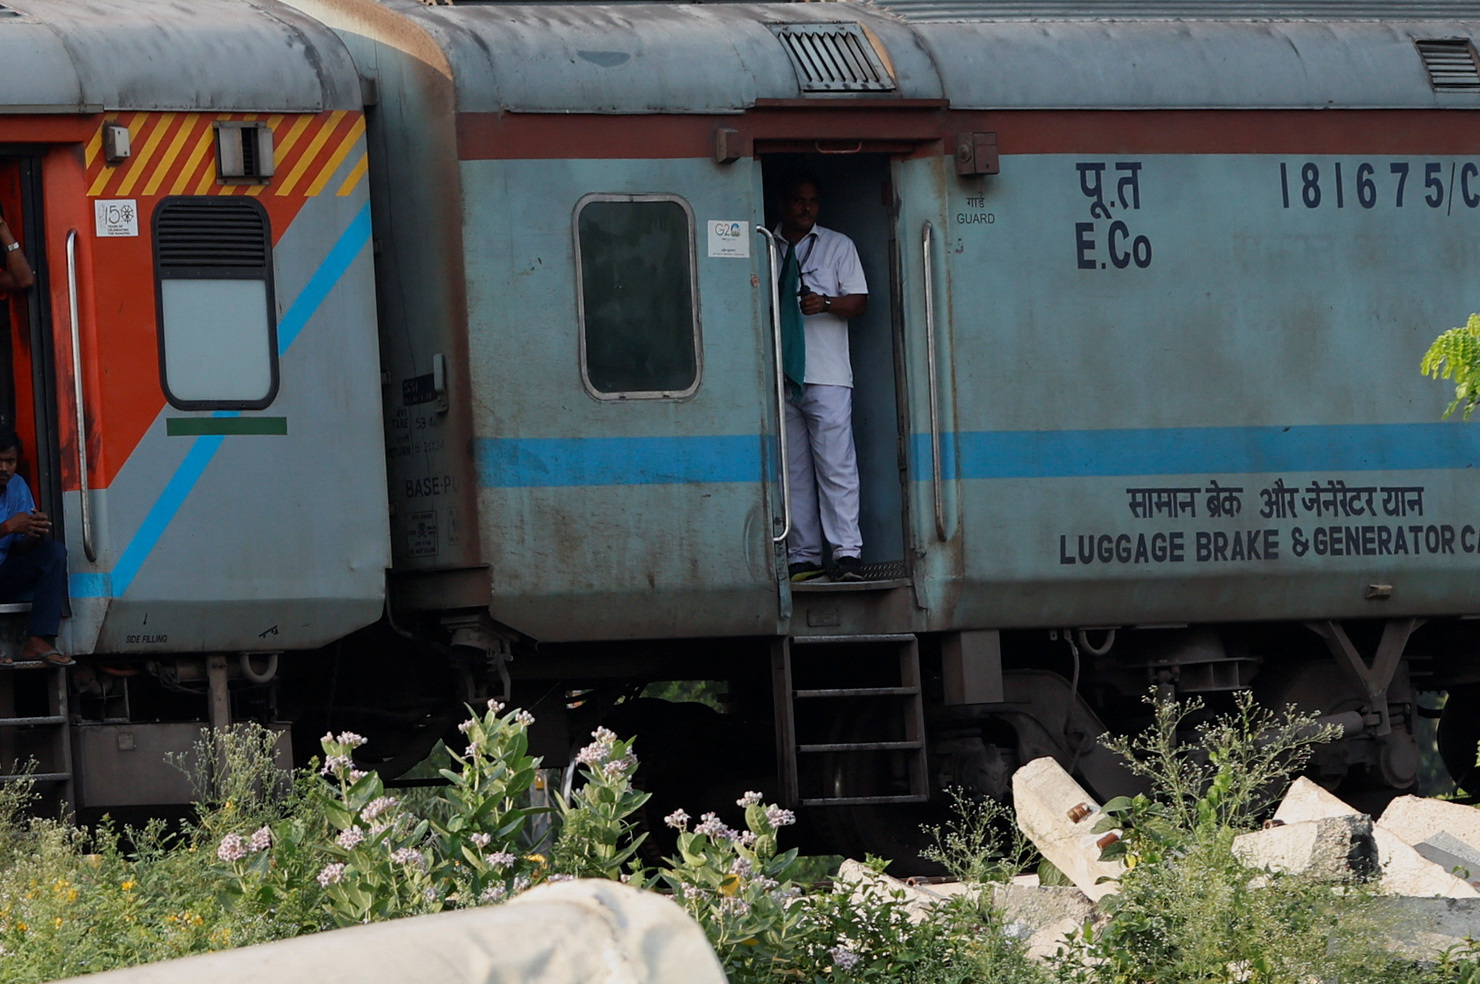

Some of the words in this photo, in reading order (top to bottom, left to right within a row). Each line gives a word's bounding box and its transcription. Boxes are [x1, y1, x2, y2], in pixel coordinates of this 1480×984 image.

[1280, 162, 1480, 217] 181675/C
[956, 212, 996, 225] GUARD
[1075, 220, 1153, 270] E.Co
[1126, 485, 1202, 519] सामान
[1205, 479, 1244, 520] ब्रेक
[1259, 478, 1298, 520] और
[1380, 486, 1425, 518] यान
[1060, 531, 1185, 566] LUGGAGE
[1195, 528, 1280, 563] BRAKE
[1461, 522, 1480, 554] C
[125, 635, 141, 644] SIDE
[141, 634, 169, 644] FILLING
